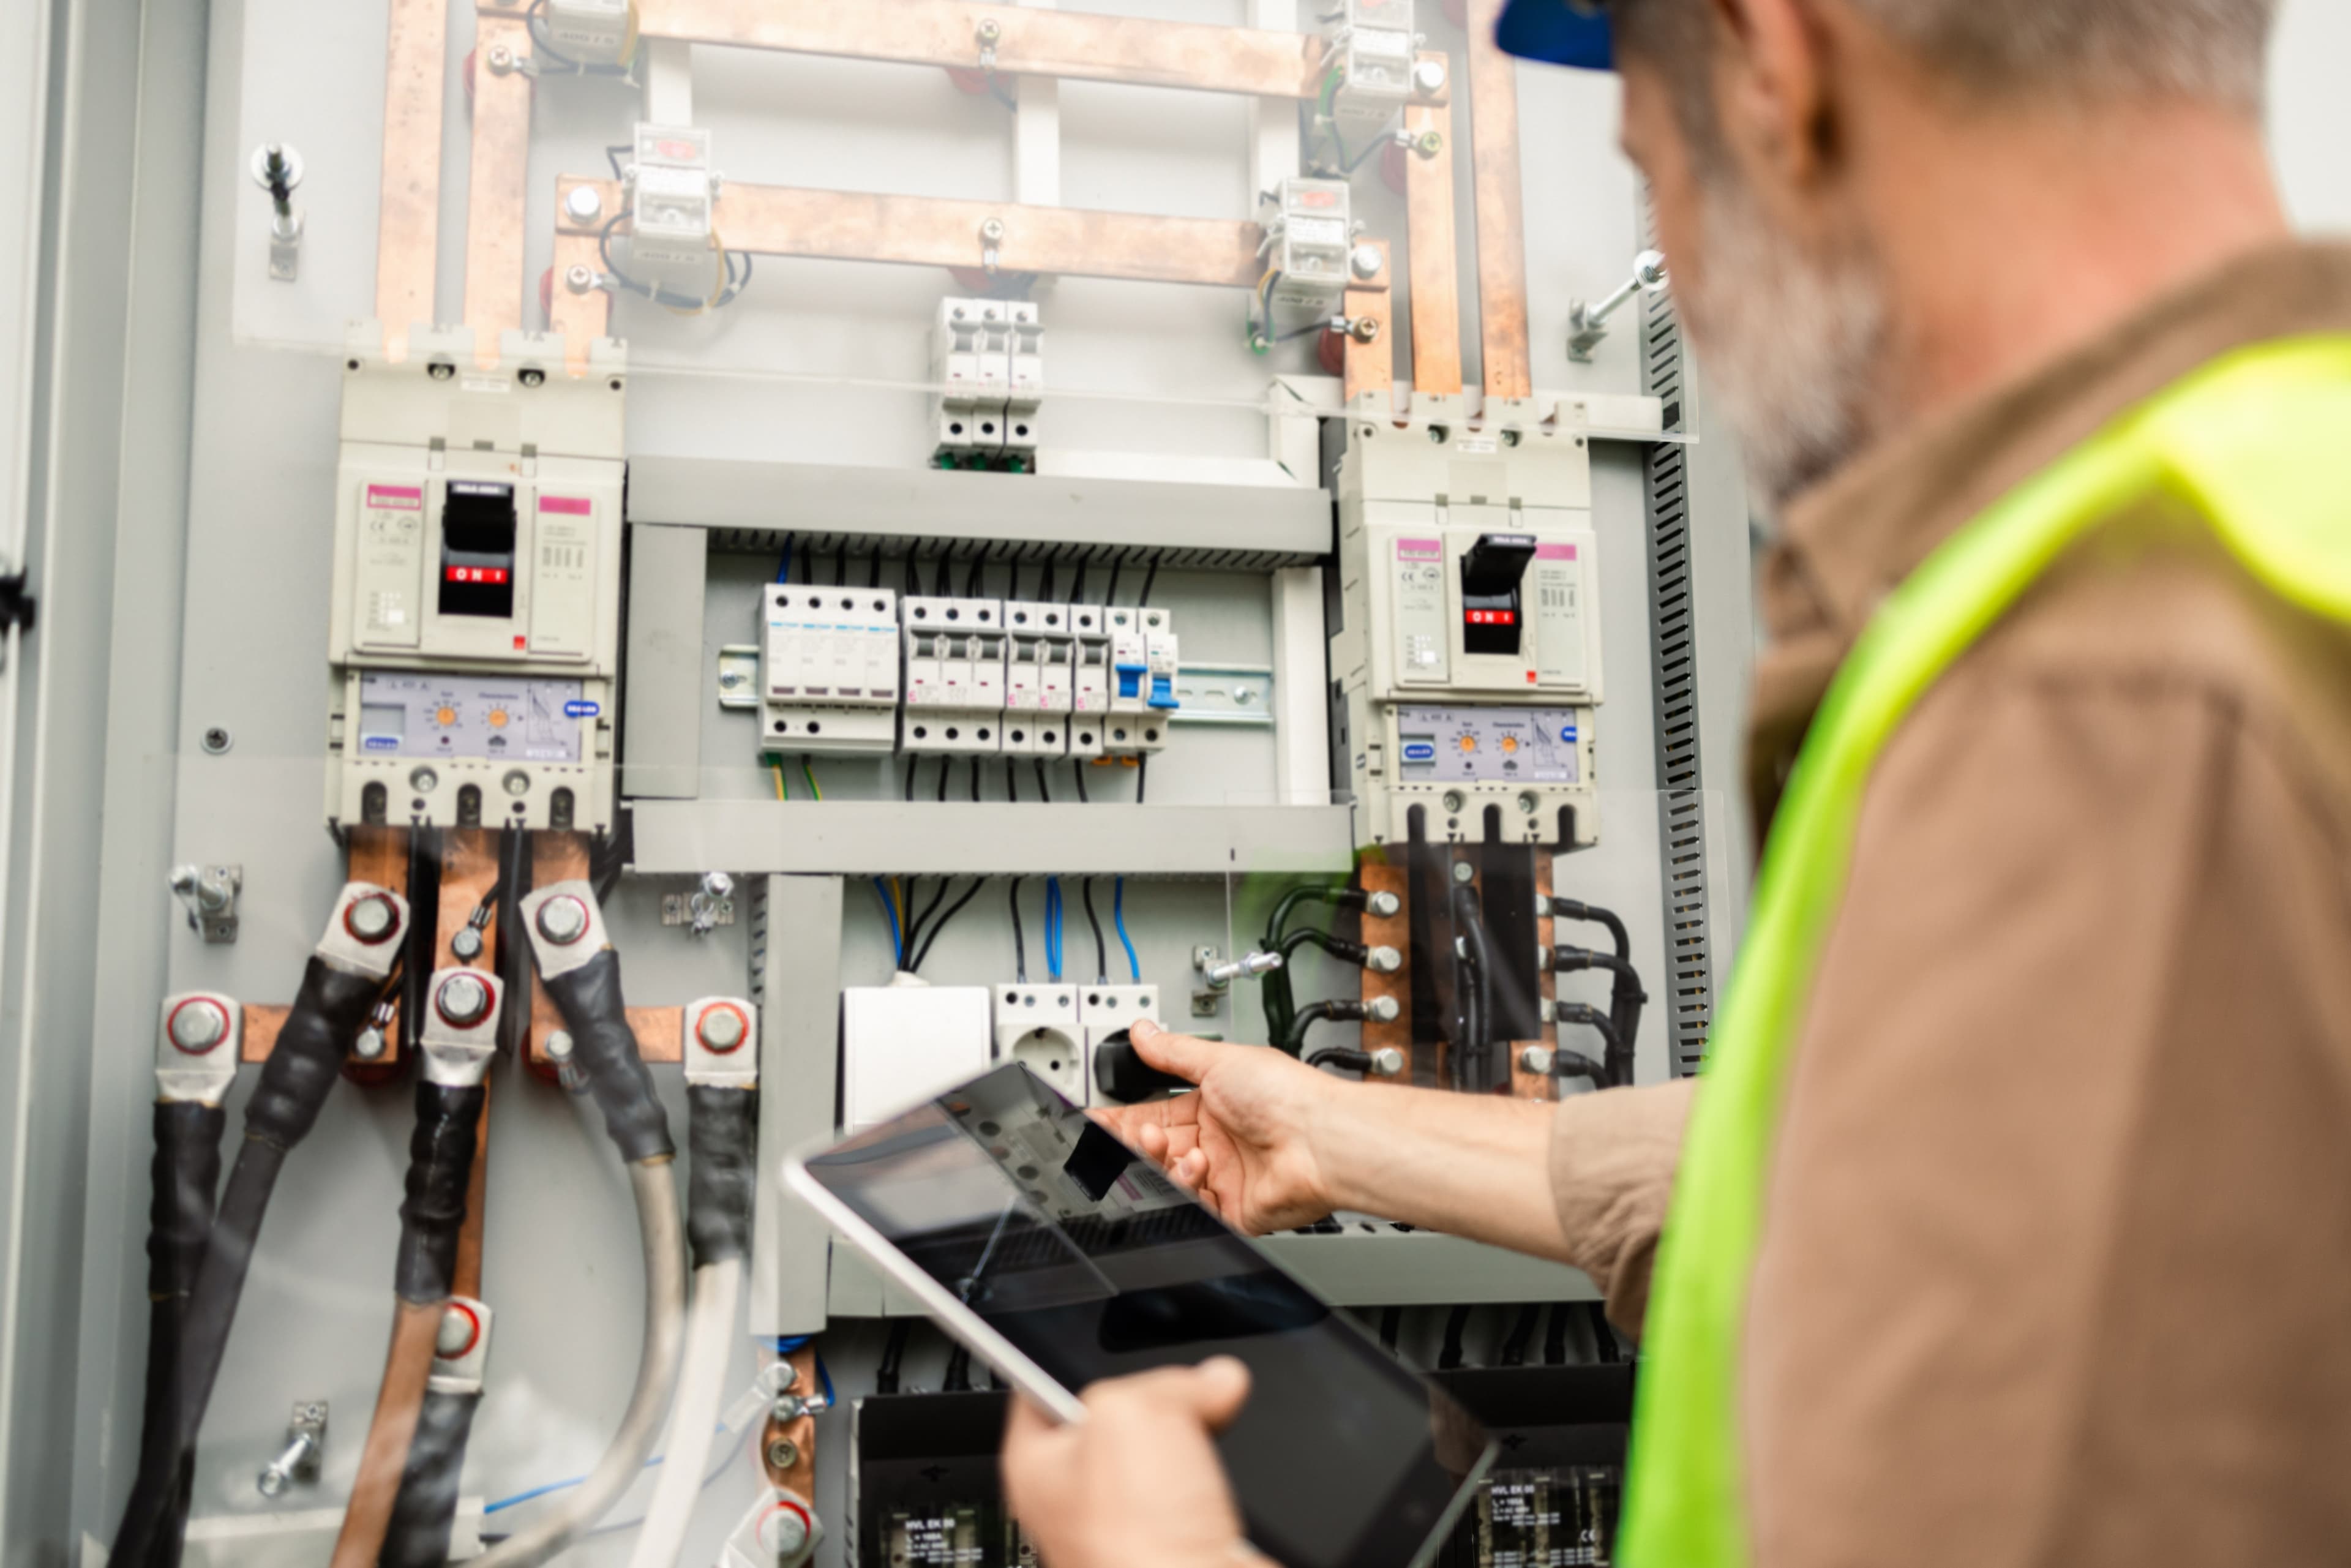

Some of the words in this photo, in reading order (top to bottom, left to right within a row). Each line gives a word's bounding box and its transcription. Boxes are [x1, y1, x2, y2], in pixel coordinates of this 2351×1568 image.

[456, 568, 482, 582] ON
[1401, 571, 1414, 582] CE
[1472, 611, 1494, 623] ON
[1580, 1529, 1596, 1542] CE
